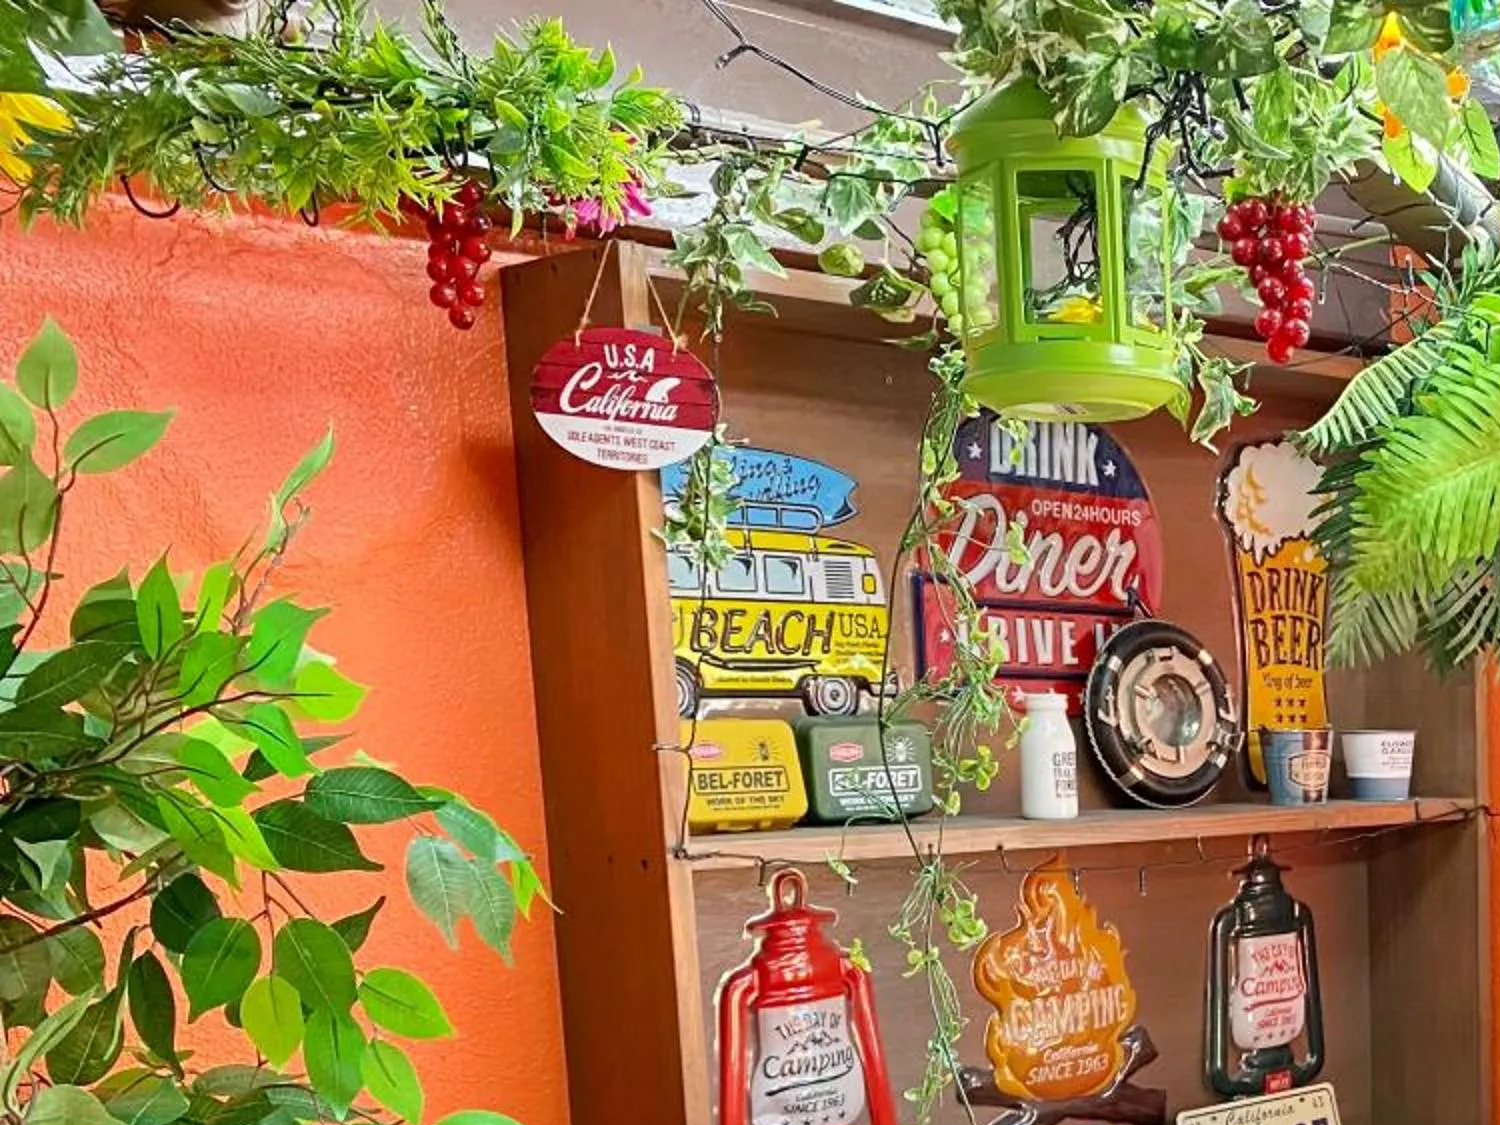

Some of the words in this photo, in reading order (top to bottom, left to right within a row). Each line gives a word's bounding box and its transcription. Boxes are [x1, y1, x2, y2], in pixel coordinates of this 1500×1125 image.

[558, 361, 679, 423] California
[1246, 567, 1325, 618] DRINK
[689, 606, 836, 656] BEACH
[838, 613, 884, 639] USA
[1249, 613, 1322, 672] BEER
[697, 770, 784, 791] BEL-FORET
[763, 1045, 855, 1080] Camping
[1025, 1060, 1074, 1086] SINCE
